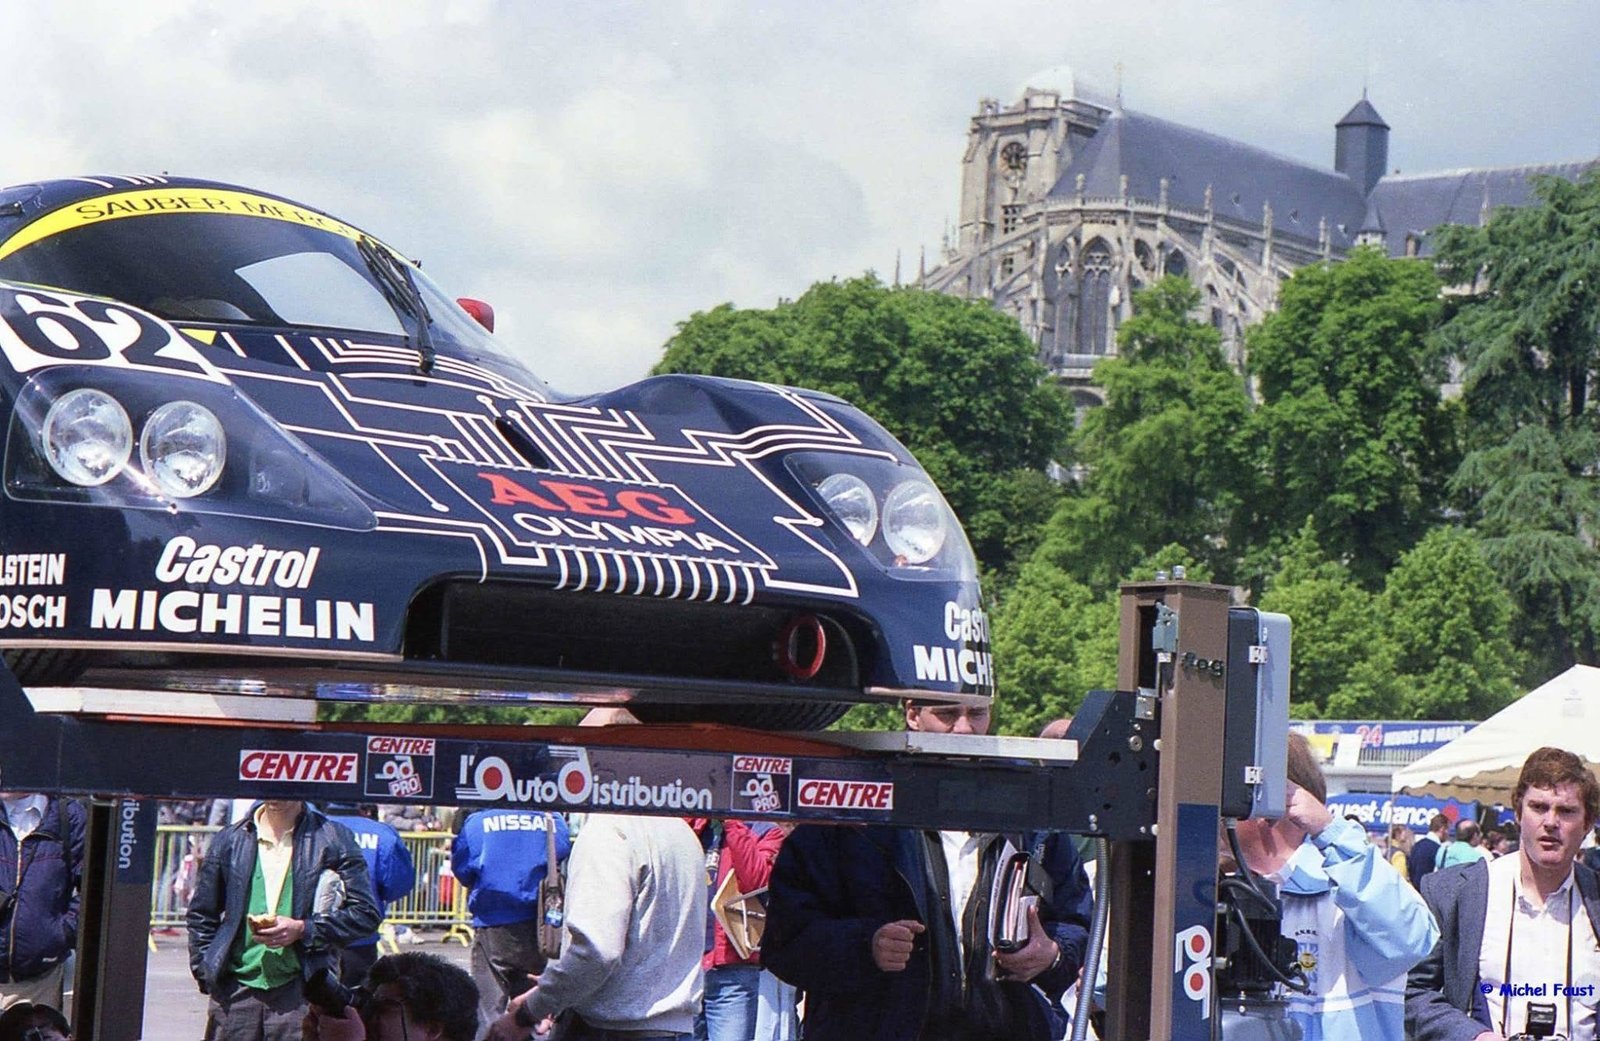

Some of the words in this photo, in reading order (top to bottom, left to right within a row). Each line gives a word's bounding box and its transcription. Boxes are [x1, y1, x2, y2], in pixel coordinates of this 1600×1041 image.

[75, 196, 231, 220] SAUBER
[2, 288, 209, 376] 62
[478, 473, 696, 524] AEG
[512, 512, 740, 553] OLYMPIA
[155, 536, 320, 588] Castrol
[90, 588, 375, 641] MICHELIN
[368, 738, 434, 754] CENTRE
[239, 752, 356, 781] CENTRE
[734, 757, 790, 773] CENTRE
[391, 777, 418, 796] PRO
[799, 781, 892, 808] CENTRE
[753, 794, 779, 812] PRO
